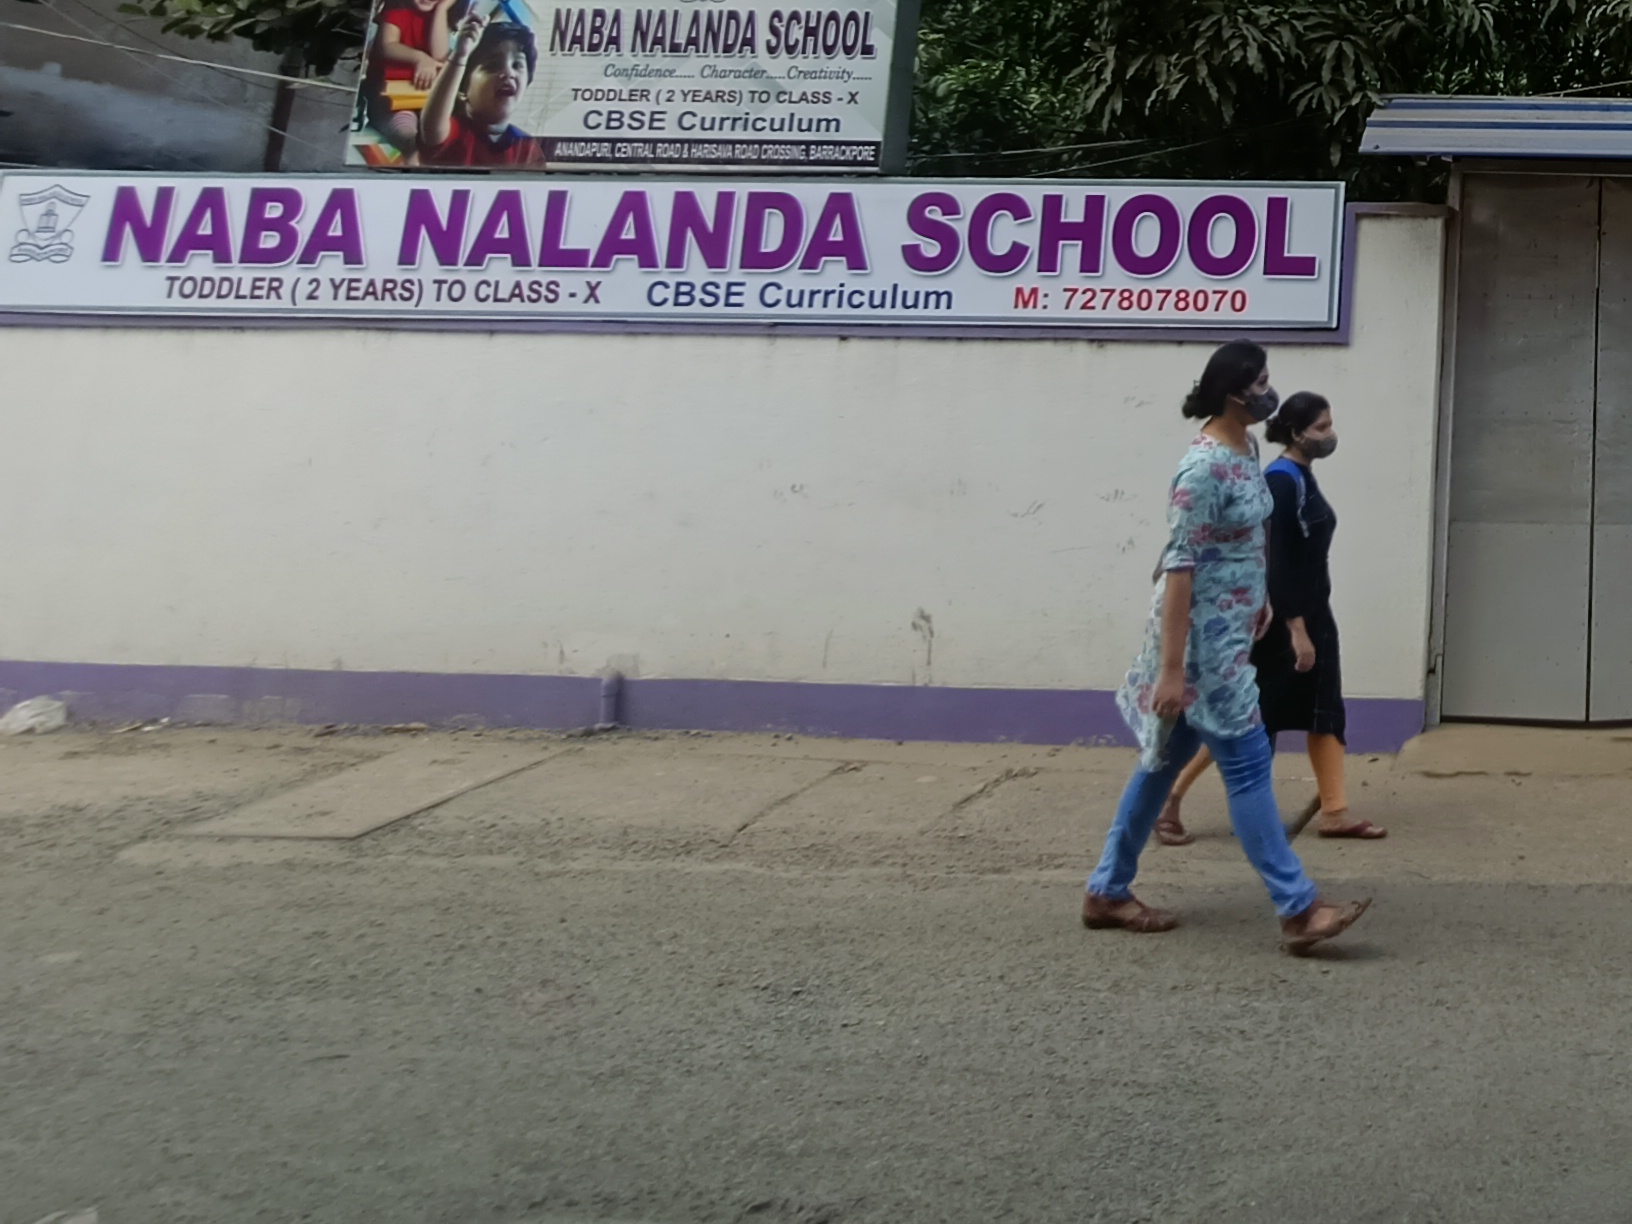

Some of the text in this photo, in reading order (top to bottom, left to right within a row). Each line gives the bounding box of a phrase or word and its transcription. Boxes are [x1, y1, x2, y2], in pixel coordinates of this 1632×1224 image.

[550, 8, 876, 60] NABA NALANDA SCHOOL
[572, 88, 650, 102] TODDLER
[681, 89, 743, 107] YEARS)
[749, 91, 770, 103] TO
[776, 91, 832, 104] CLASS
[846, 91, 859, 104] X
[583, 110, 841, 132] CBSE Curriculum
[614, 142, 654, 158] CENTRAL
[656, 143, 681, 158] ROAD
[682, 143, 689, 158] &
[734, 144, 759, 159] ROAD
[809, 145, 875, 161] BARRACKPORE
[102, 185, 1317, 276] NABA NALANDA SCHOOL
[165, 277, 283, 301] TODDLER
[306, 279, 320, 302] 2
[329, 279, 424, 307] YEARS)
[433, 280, 466, 303] TO
[477, 281, 560, 304] CLASS
[582, 282, 602, 304] X
[646, 281, 746, 308] CBSE
[759, 282, 953, 310] Curriculum
[1013, 287, 1049, 310] M:
[1062, 288, 1247, 313] 7278078070
